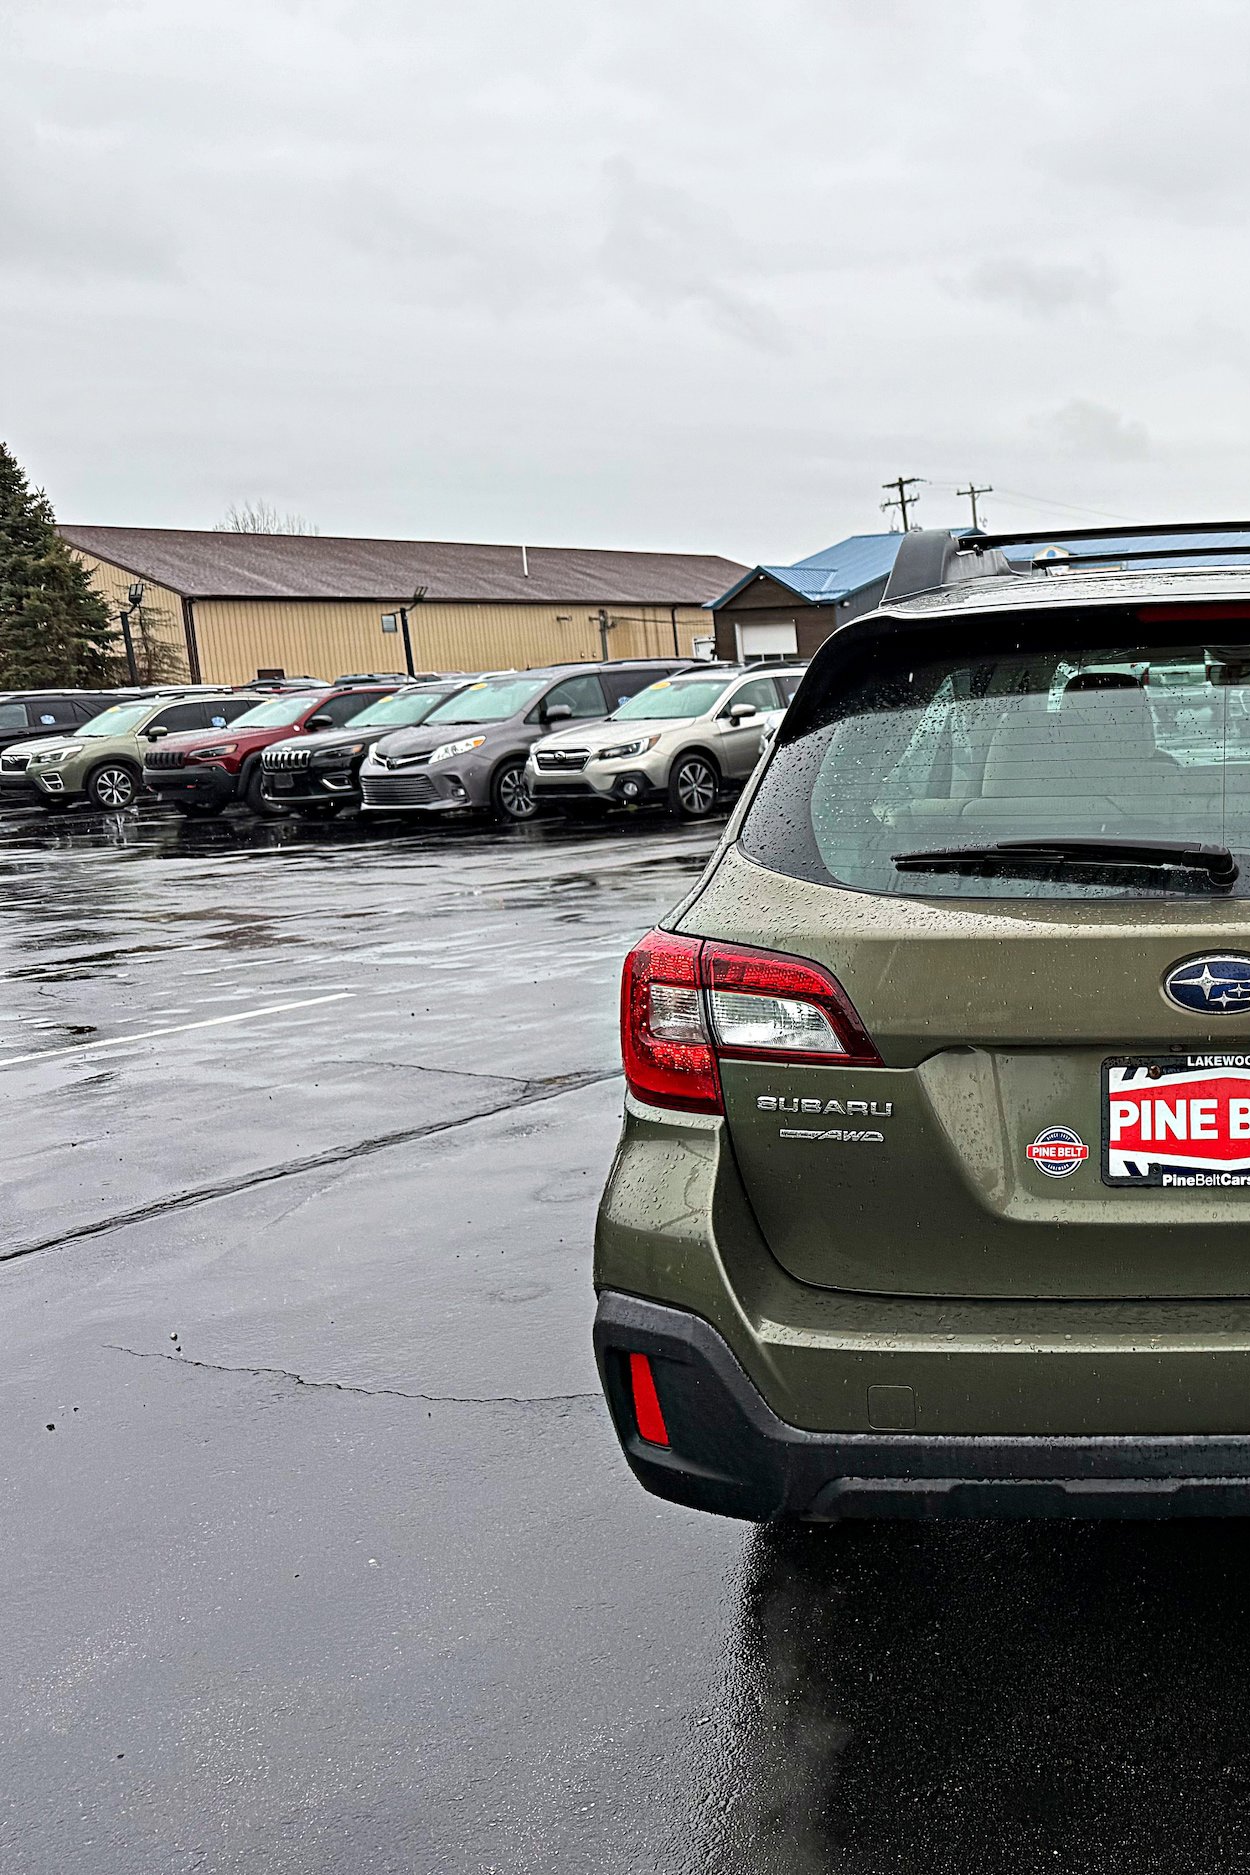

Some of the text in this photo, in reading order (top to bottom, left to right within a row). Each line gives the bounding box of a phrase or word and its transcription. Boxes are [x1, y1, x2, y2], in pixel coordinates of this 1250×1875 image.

[756, 1095, 893, 1117] SUBARU
[1109, 1098, 1219, 1142] PINE
[818, 1129, 885, 1142] AWD
[1032, 1147, 1083, 1157] PINE BELT
